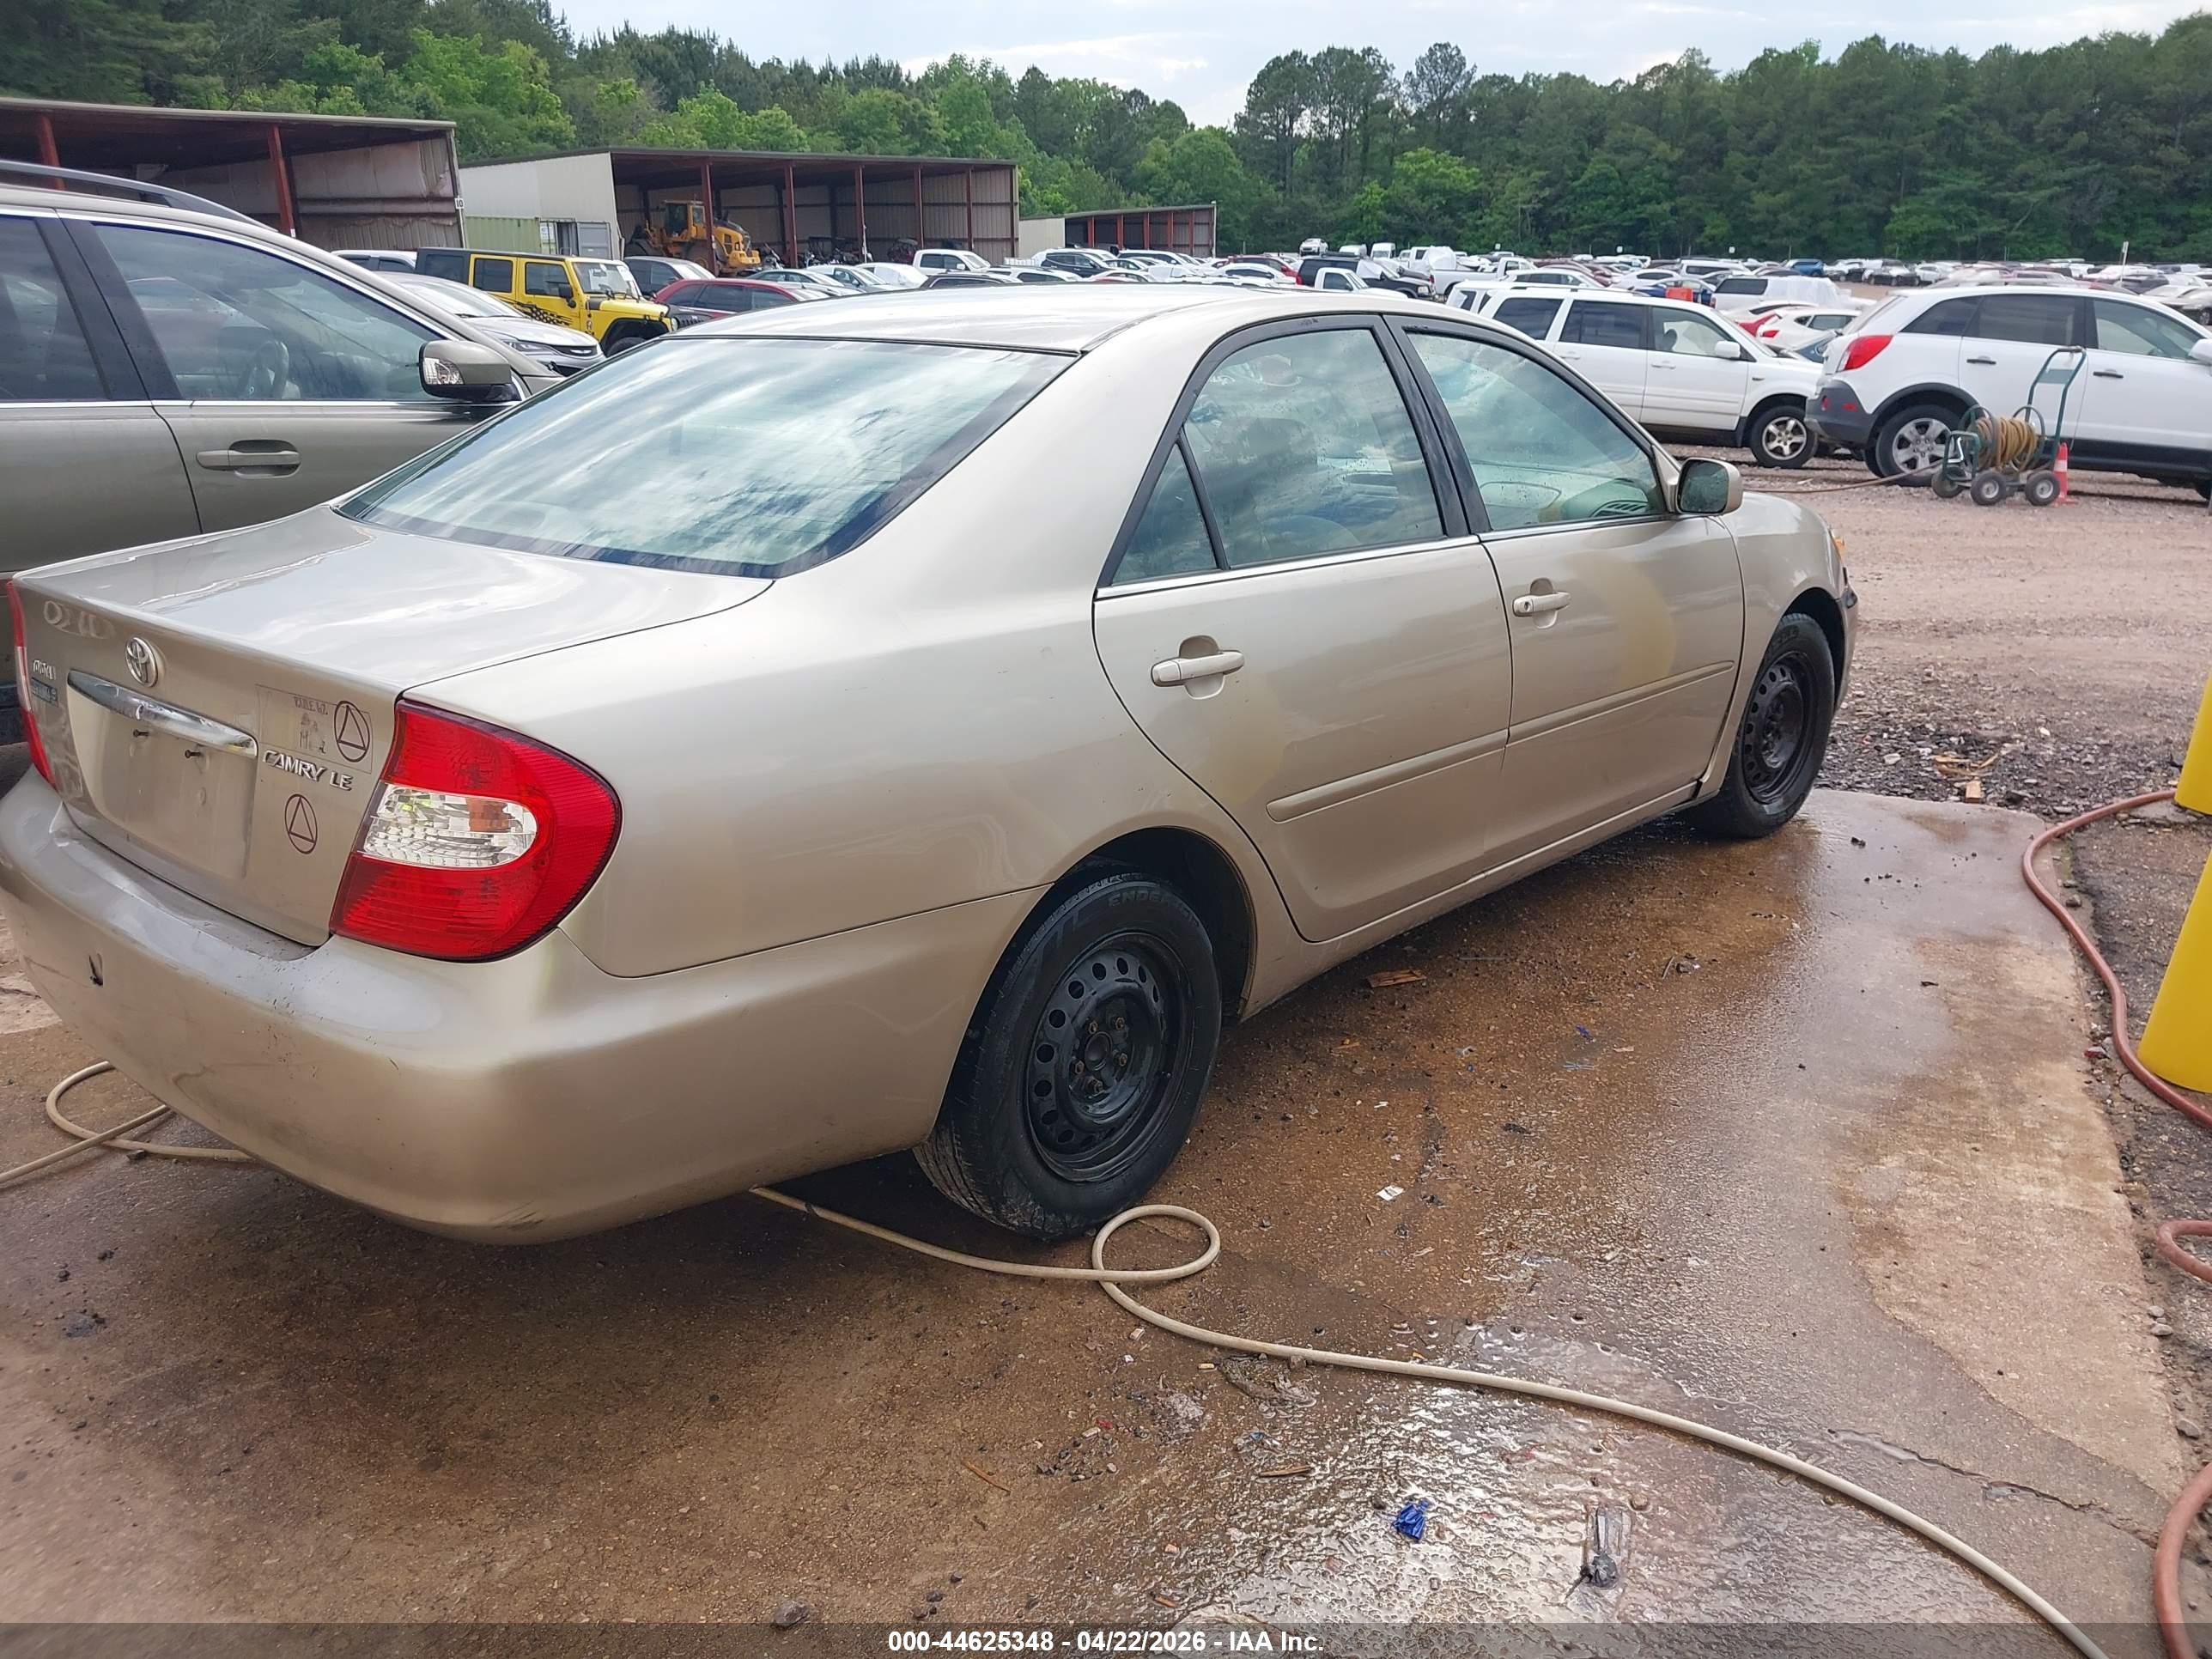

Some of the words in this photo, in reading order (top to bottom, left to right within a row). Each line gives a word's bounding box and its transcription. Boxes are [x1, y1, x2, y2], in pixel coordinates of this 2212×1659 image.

[456, 198, 464, 208] 10
[262, 750, 326, 781] CAMRY
[330, 771, 353, 791] LE
